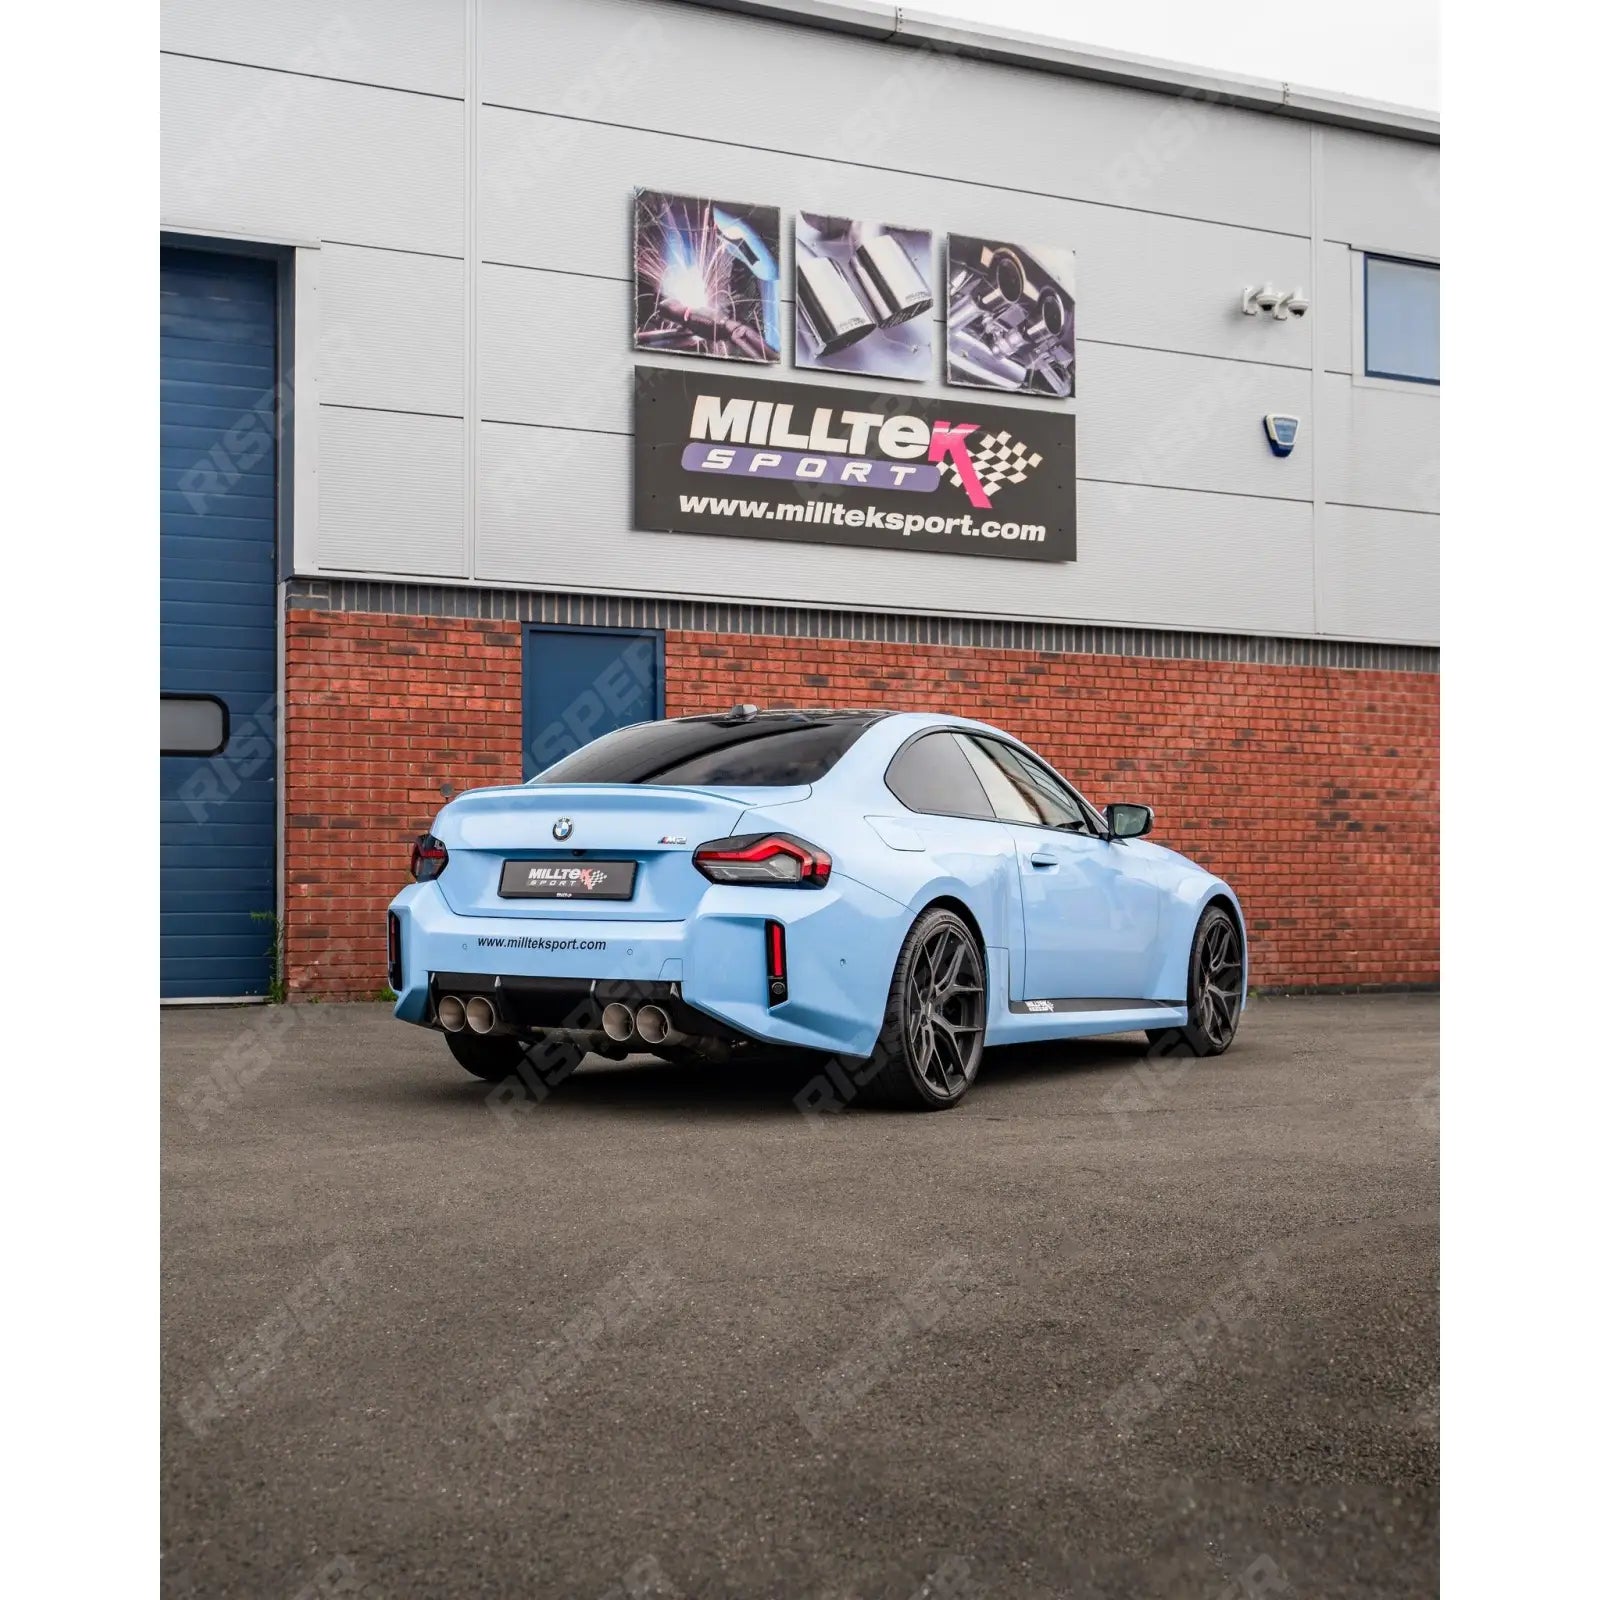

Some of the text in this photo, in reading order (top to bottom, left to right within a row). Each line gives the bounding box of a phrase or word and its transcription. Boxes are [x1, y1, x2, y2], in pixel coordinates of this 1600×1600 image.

[701, 447, 918, 488] SPORT
[679, 494, 1046, 542] www.millteksport.com
[477, 937, 607, 953] www.millteksport.com
